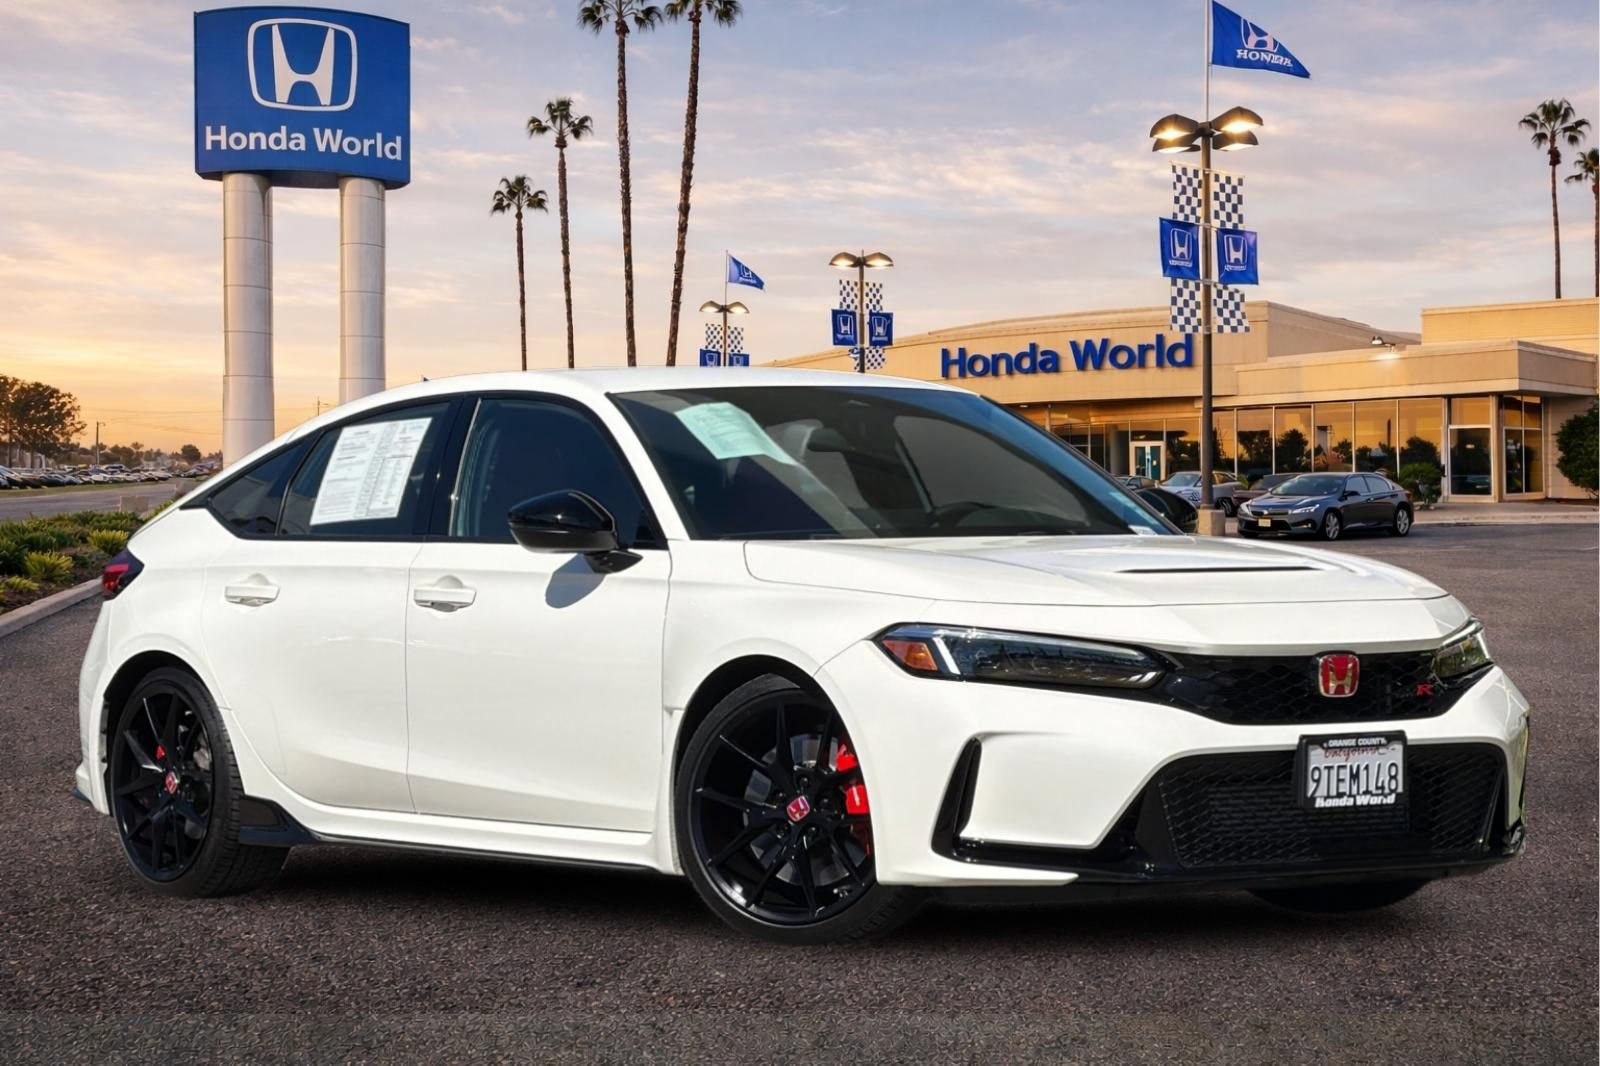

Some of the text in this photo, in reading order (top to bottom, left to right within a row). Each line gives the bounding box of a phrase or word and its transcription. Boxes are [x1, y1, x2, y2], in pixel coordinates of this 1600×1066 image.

[205, 125, 402, 161] Honda World
[941, 333, 1193, 379] Honda World
[1308, 761, 1399, 798] 9TEM148
[1315, 793, 1396, 808] Honda World
